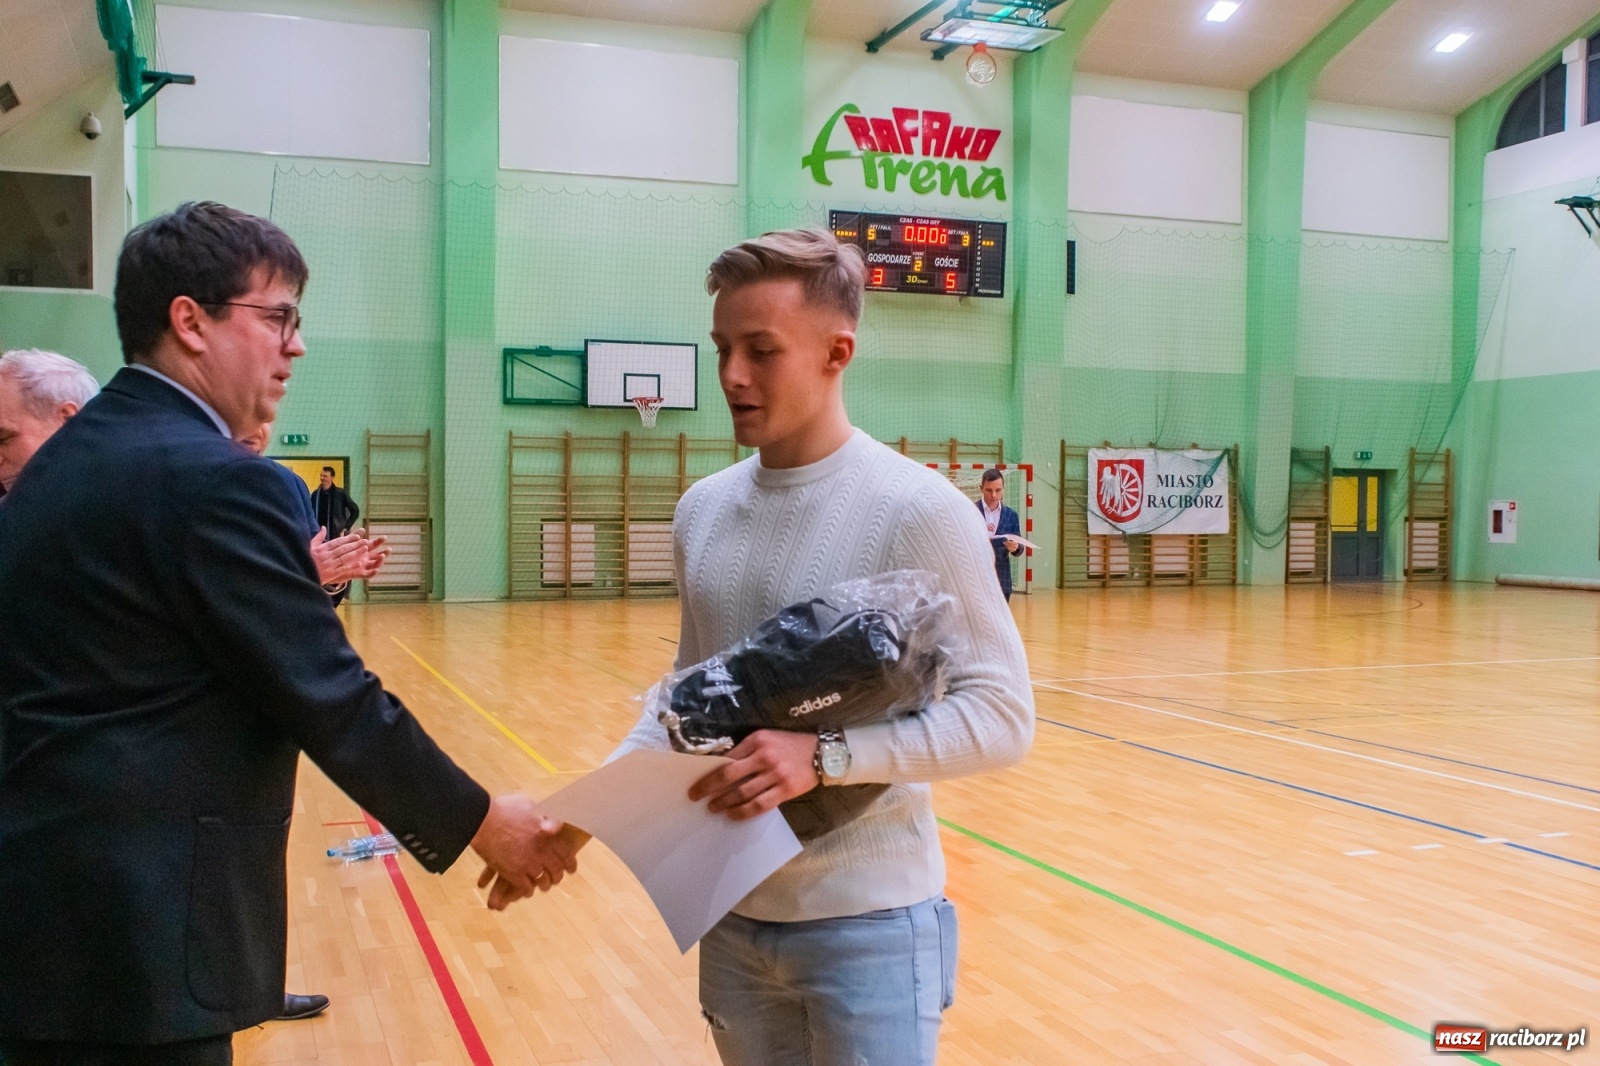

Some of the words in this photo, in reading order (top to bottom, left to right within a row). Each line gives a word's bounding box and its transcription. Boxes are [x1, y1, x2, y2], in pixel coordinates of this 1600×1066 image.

[844, 107, 1001, 161] RAFAKO
[802, 103, 1006, 201] Arena
[867, 228, 876, 241] 5
[962, 234, 970, 247] 3
[867, 252, 912, 265] GOSPODARZE
[934, 255, 960, 268] GOŚCIE
[914, 260, 923, 272] 2
[873, 268, 884, 285] 3
[946, 272, 956, 289] 5
[1156, 474, 1214, 488] MIASTO
[1147, 494, 1224, 509] RACIBORZ
[789, 692, 842, 717] adidas
